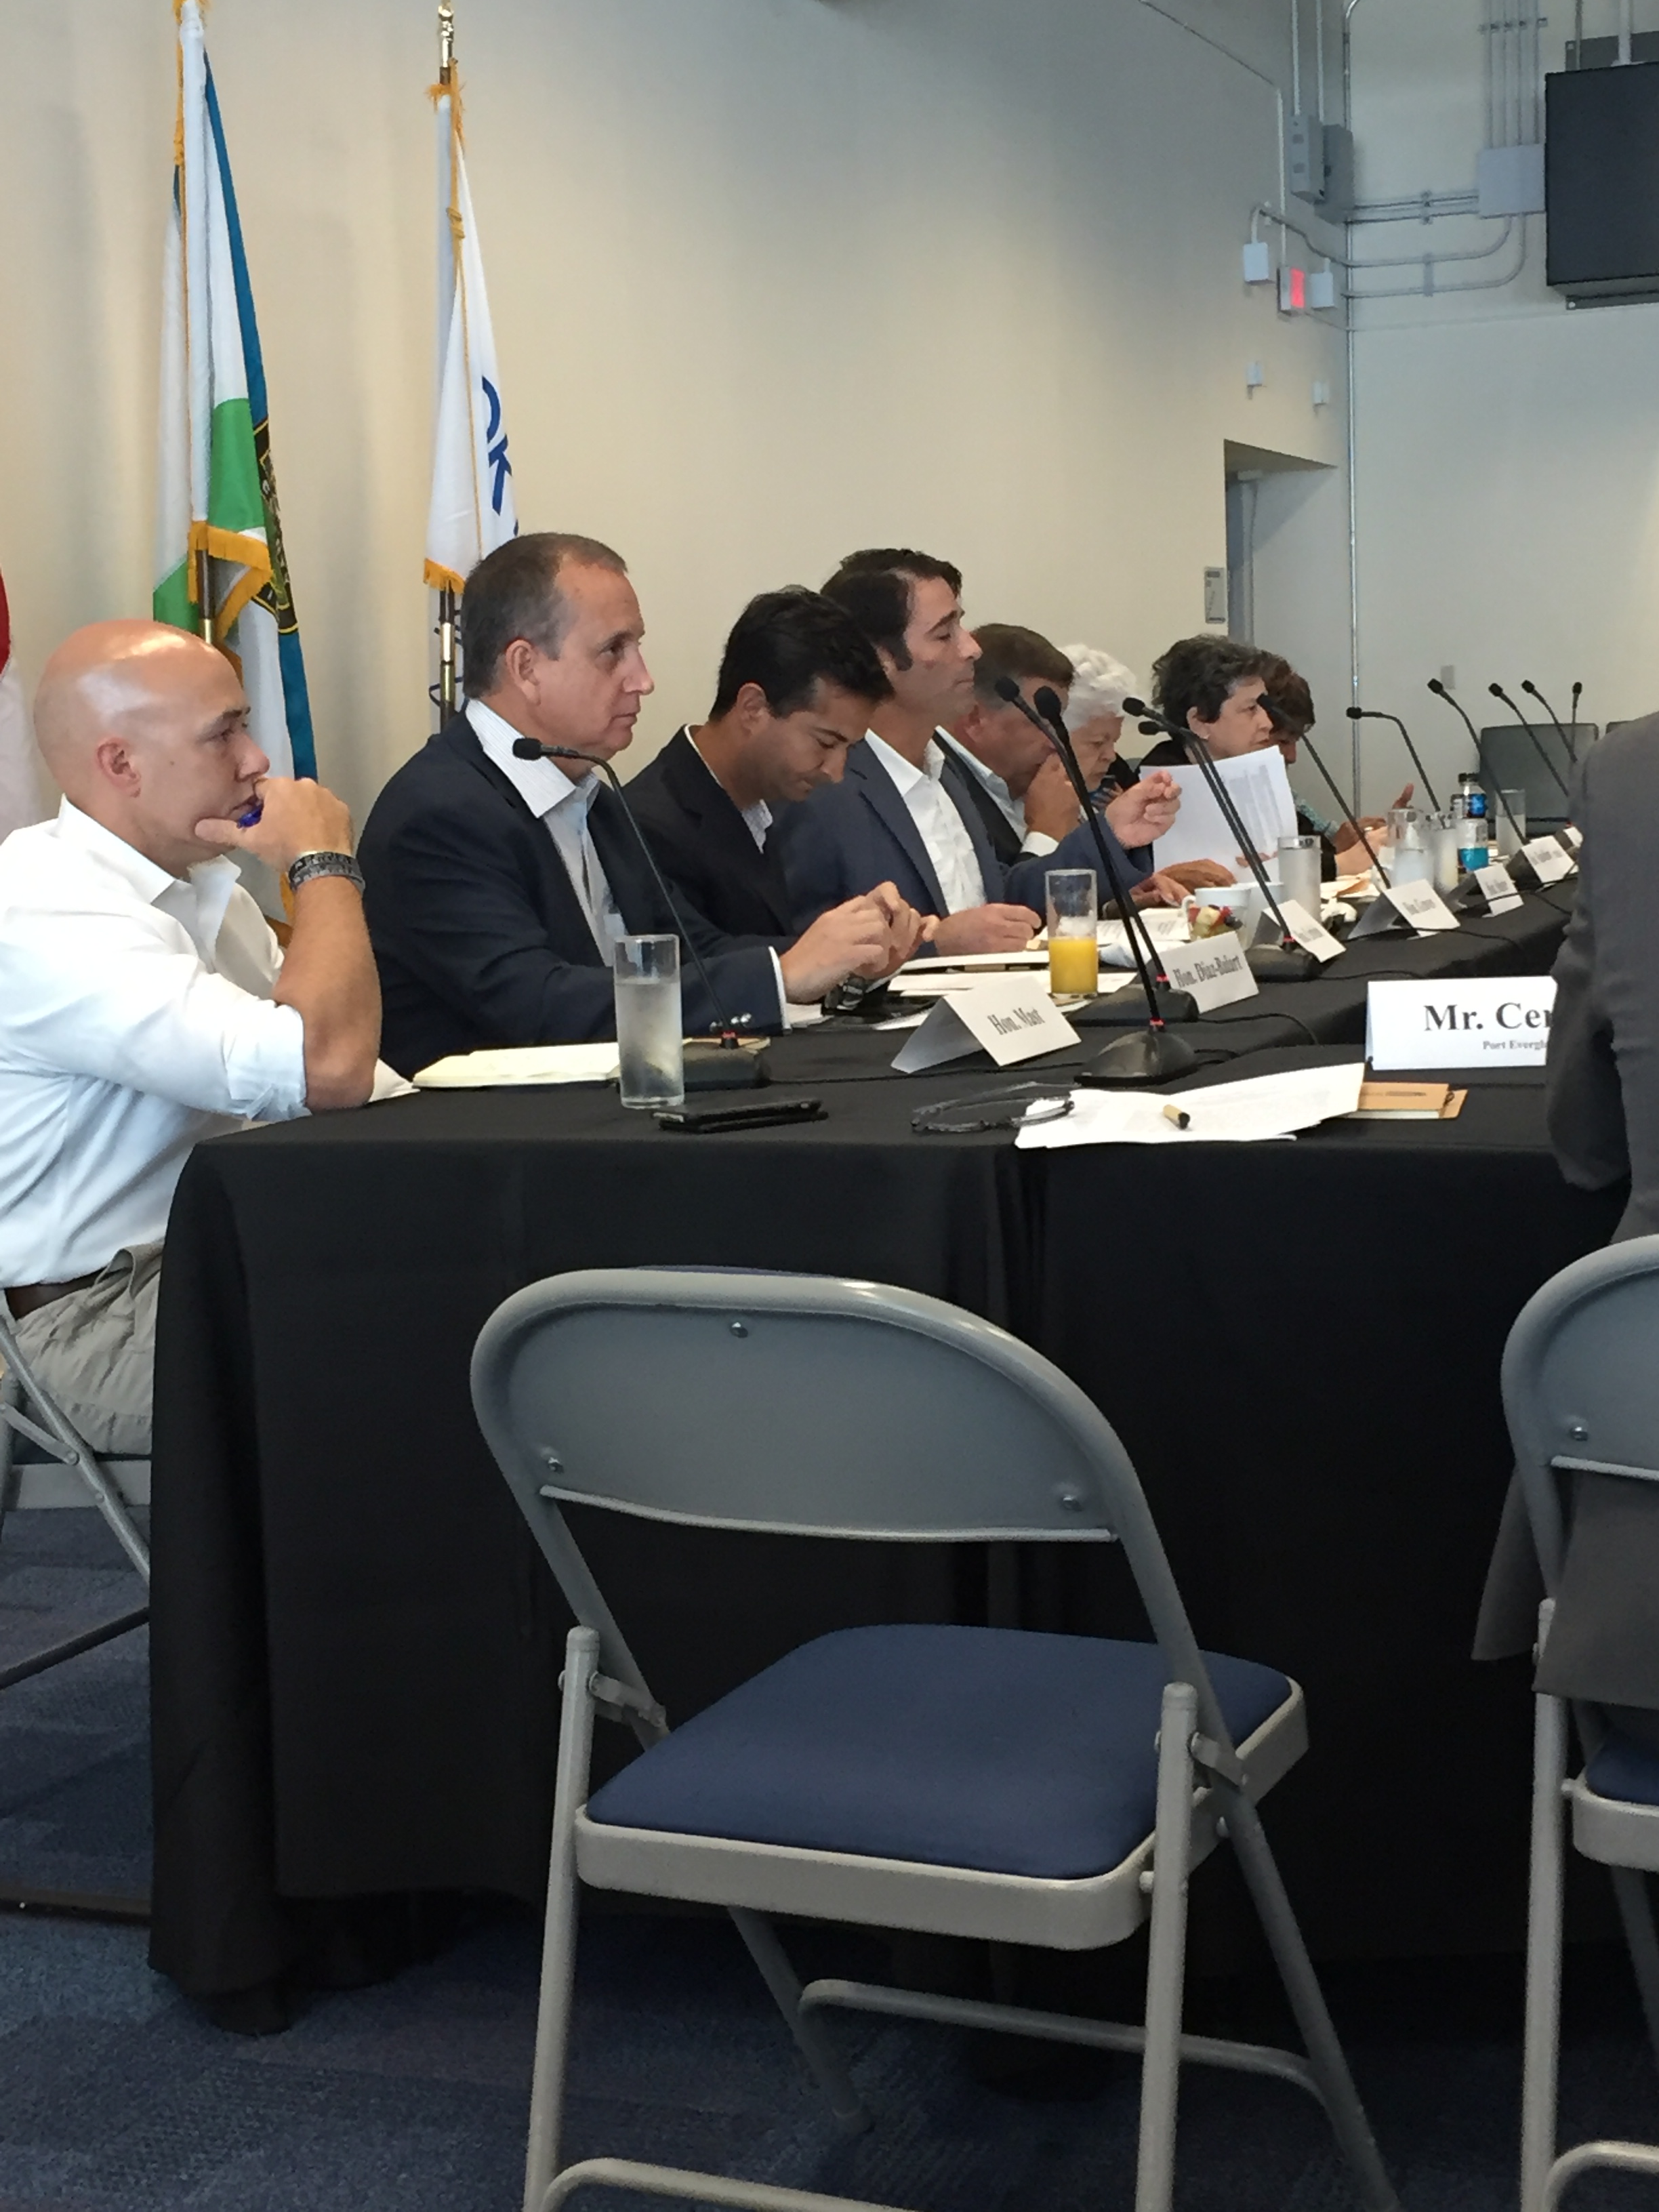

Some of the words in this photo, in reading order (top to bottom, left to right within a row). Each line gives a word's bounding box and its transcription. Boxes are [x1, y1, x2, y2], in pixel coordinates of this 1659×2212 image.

[987, 1014, 1022, 1035] Hon.
[1012, 1007, 1046, 1027] Mast
[1424, 1004, 1483, 1031] Mr.
[1483, 1040, 1505, 1050] Port
